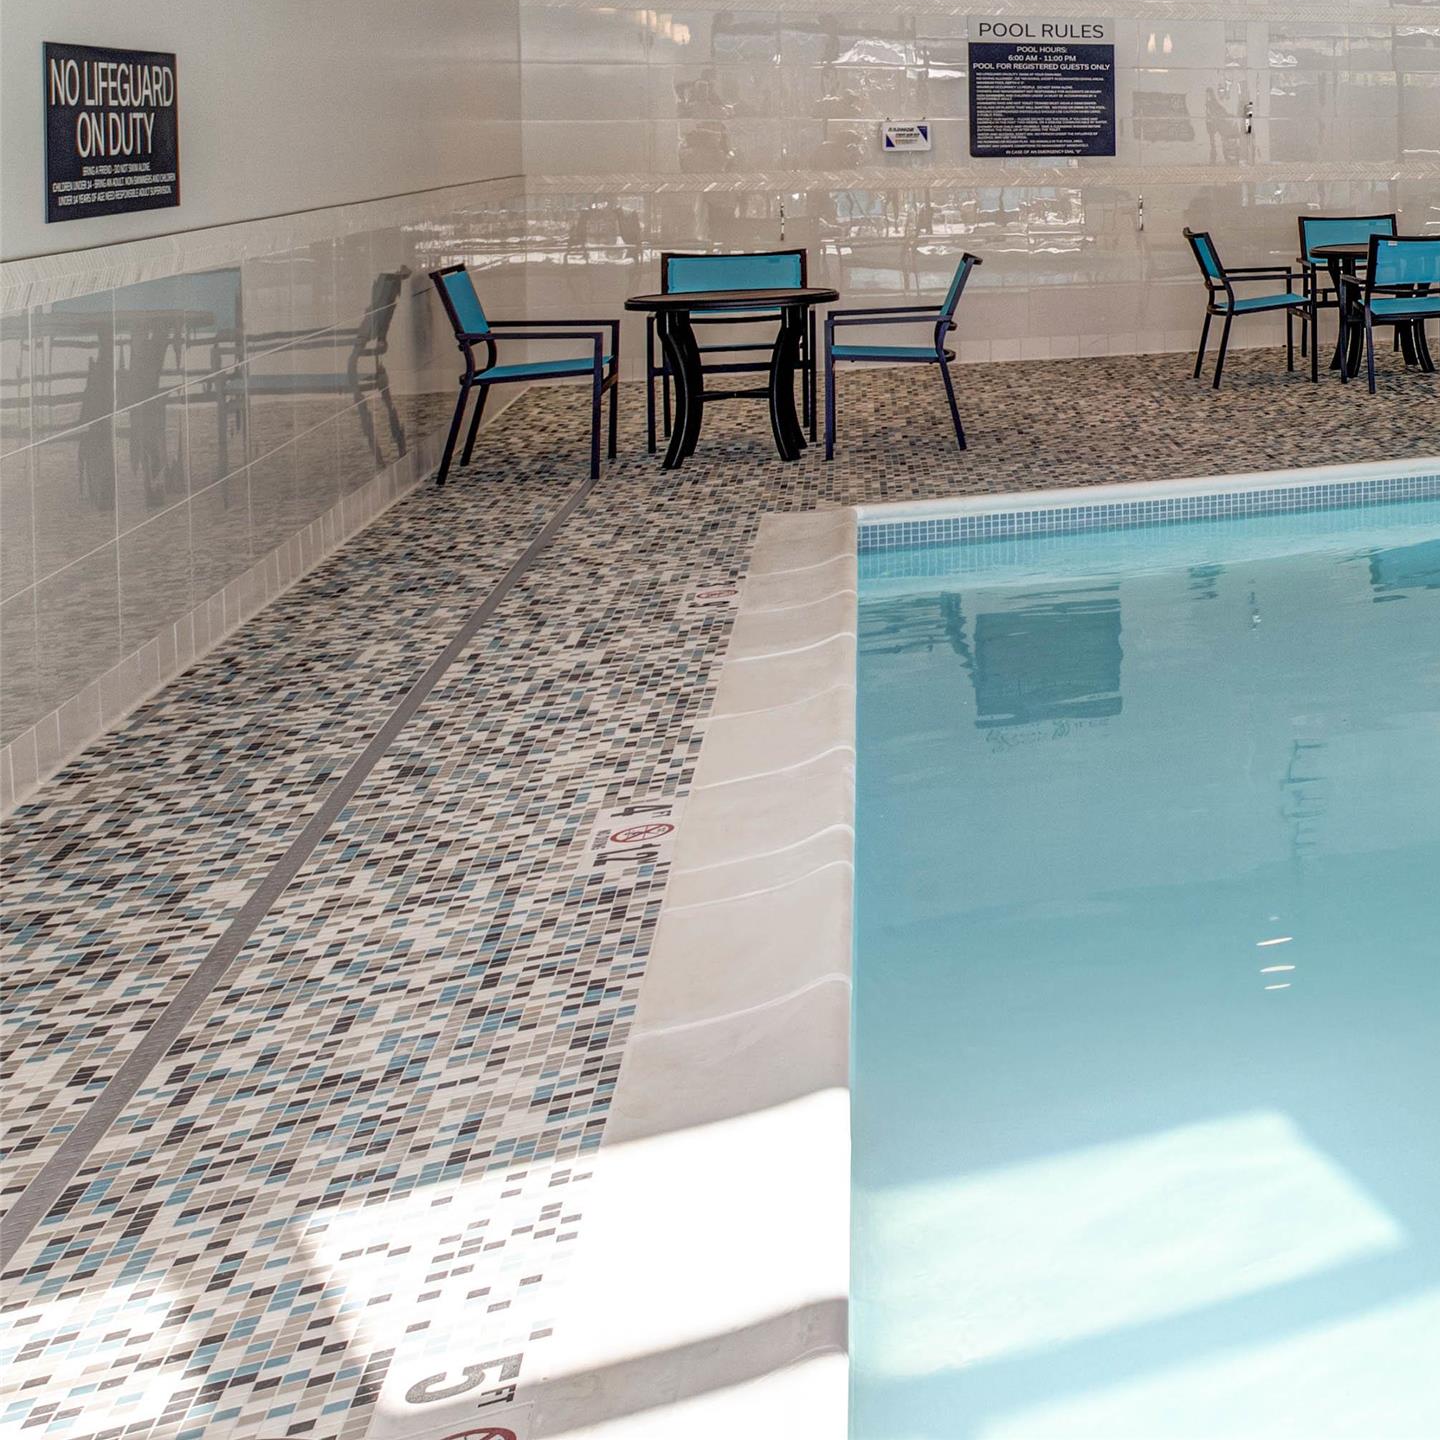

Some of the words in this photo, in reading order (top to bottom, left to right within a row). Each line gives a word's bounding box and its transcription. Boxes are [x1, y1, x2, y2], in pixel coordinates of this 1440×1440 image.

[979, 23, 1036, 38] POOL
[1041, 24, 1104, 39] RULES
[51, 59, 79, 106] NO
[84, 61, 174, 107] LIFEGUARD
[1060, 63, 1090, 71] GUESTS
[1090, 63, 1111, 71] ONLY
[77, 112, 105, 158] ON
[109, 112, 155, 155] DUTY
[405, 1353, 524, 1404] 5
[477, 1384, 517, 1408] FT
